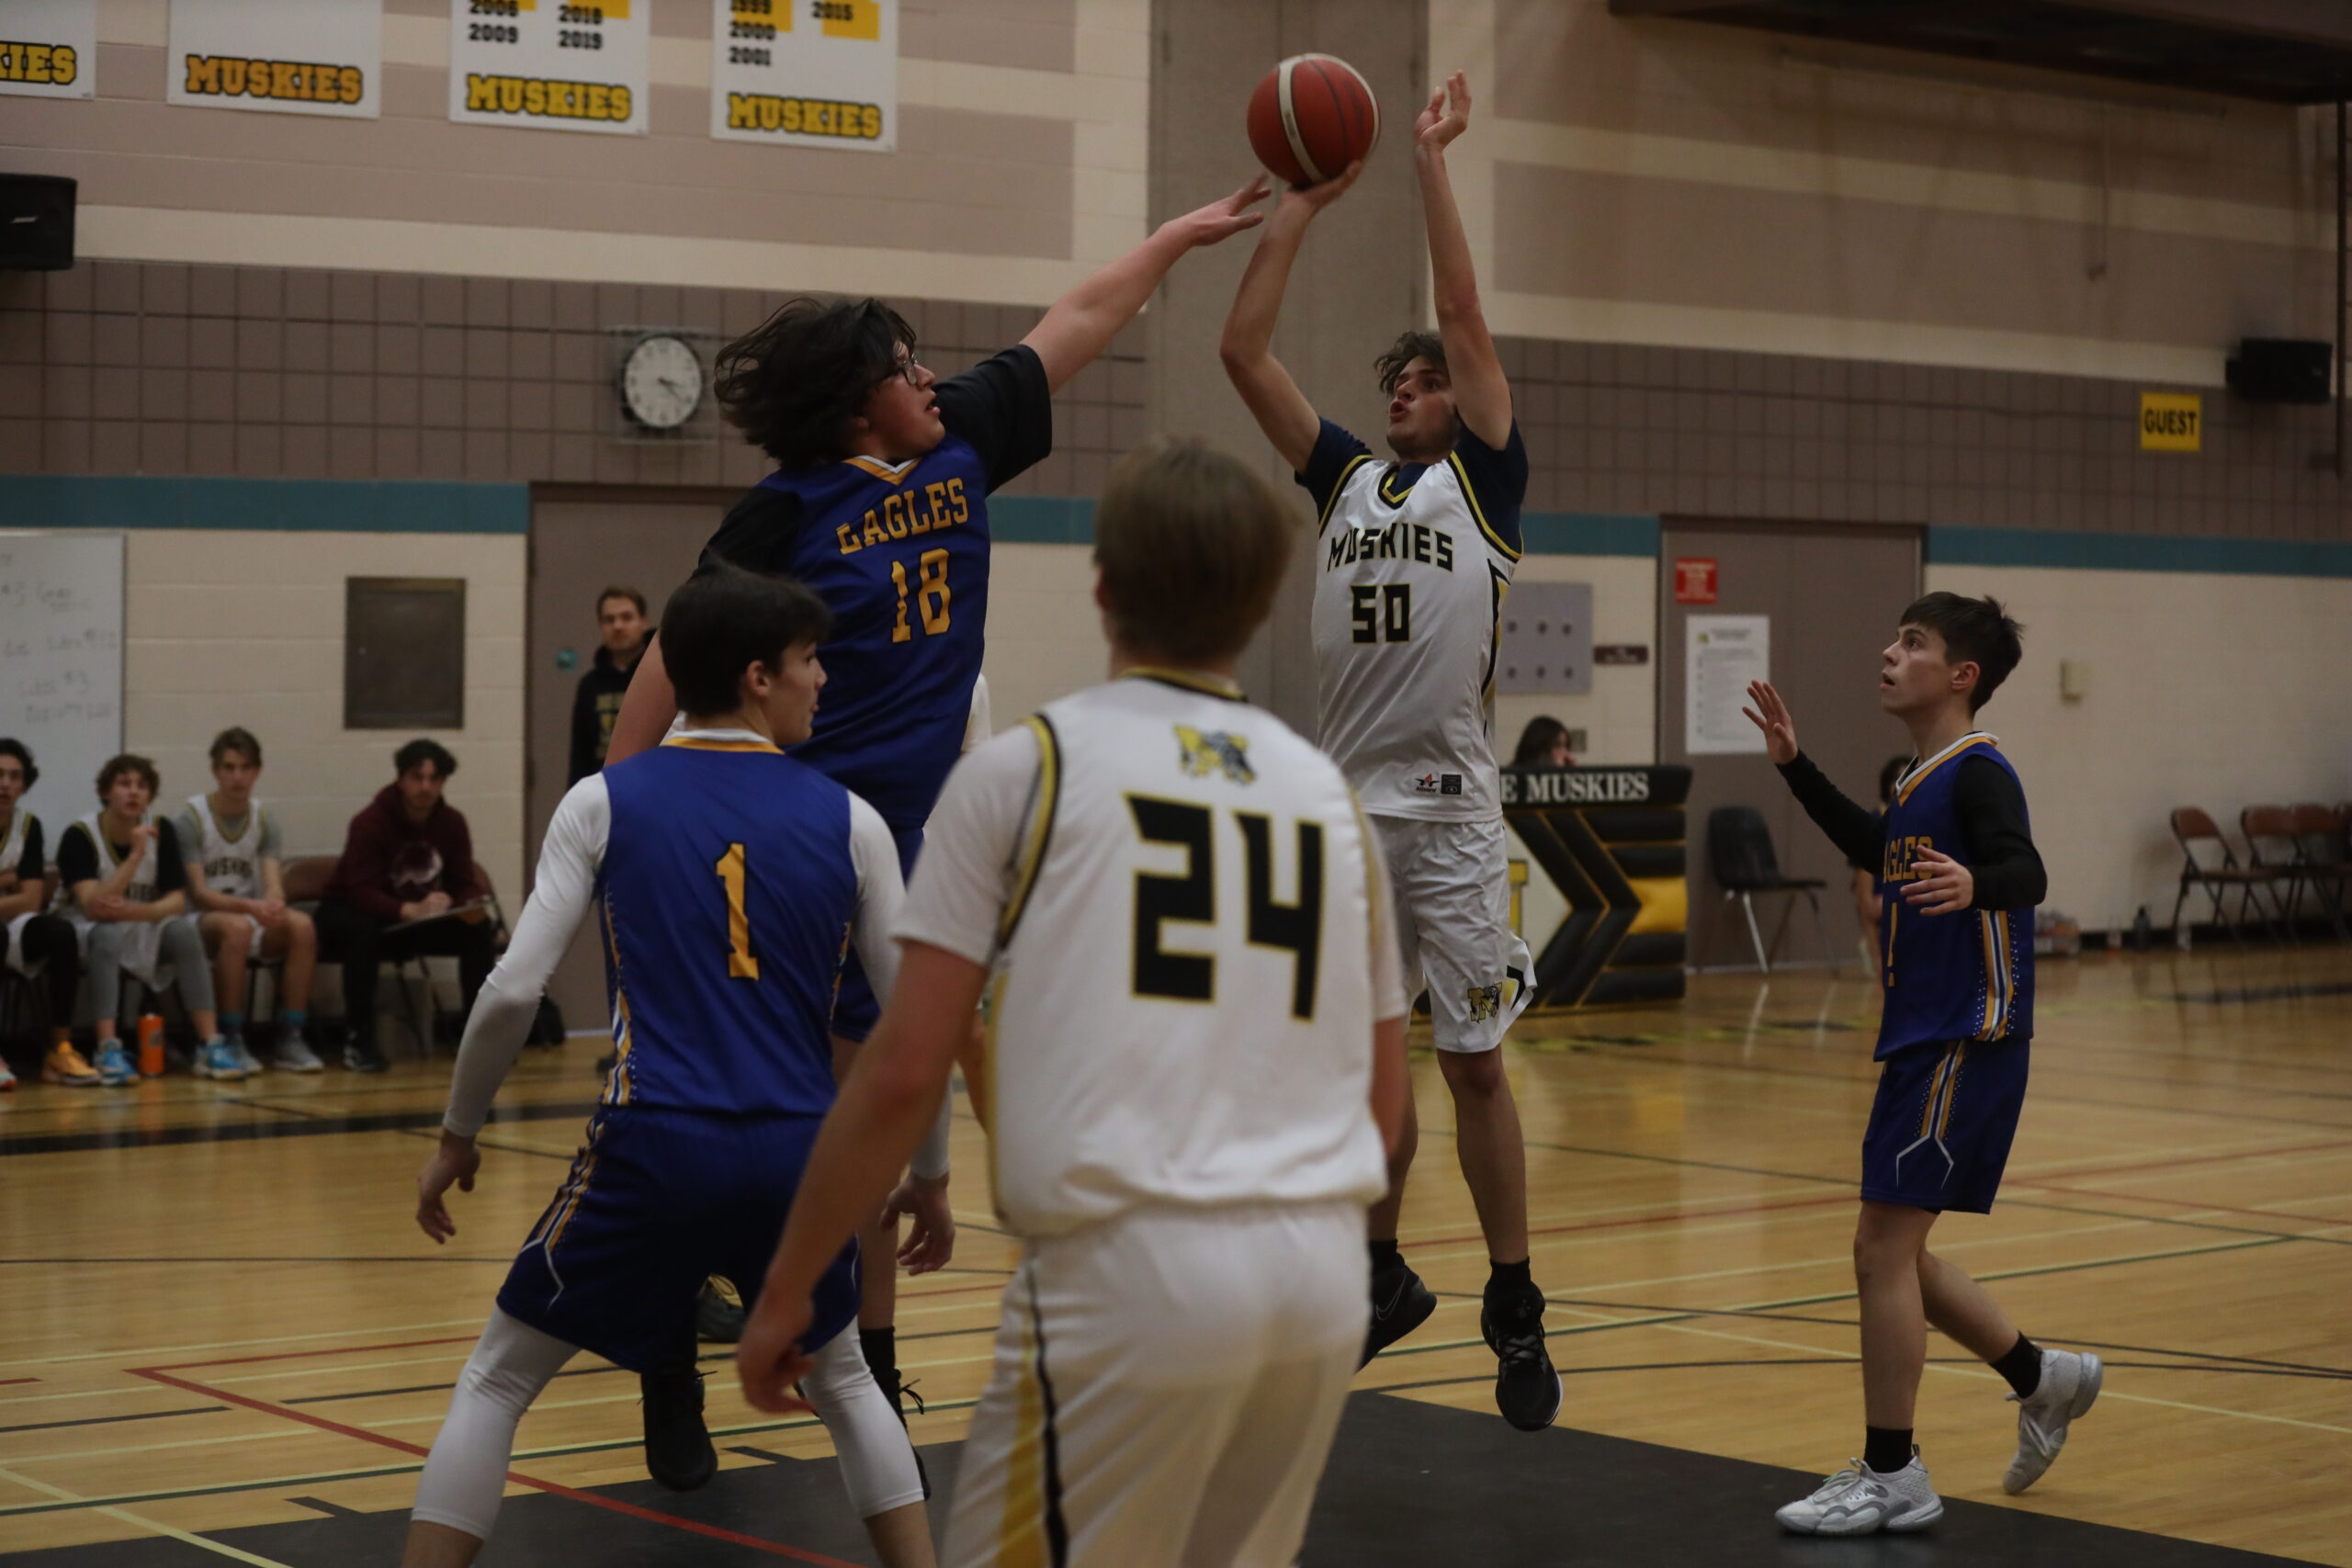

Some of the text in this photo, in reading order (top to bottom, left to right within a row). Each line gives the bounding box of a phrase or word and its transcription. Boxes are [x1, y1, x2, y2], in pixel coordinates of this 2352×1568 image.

[185, 54, 364, 105] MUSKIES
[466, 73, 632, 122] MUSKIES
[728, 93, 882, 140] MUSKIES
[2143, 408, 2198, 436] GUEST
[836, 477, 969, 556] EAGLES
[1327, 522, 1454, 574] MUSKIES
[890, 547, 952, 644] 18
[1350, 582, 1411, 645] 50
[1525, 772, 1650, 803] MUSKIES
[716, 841, 760, 982] 1
[1122, 790, 1326, 1023] 24
